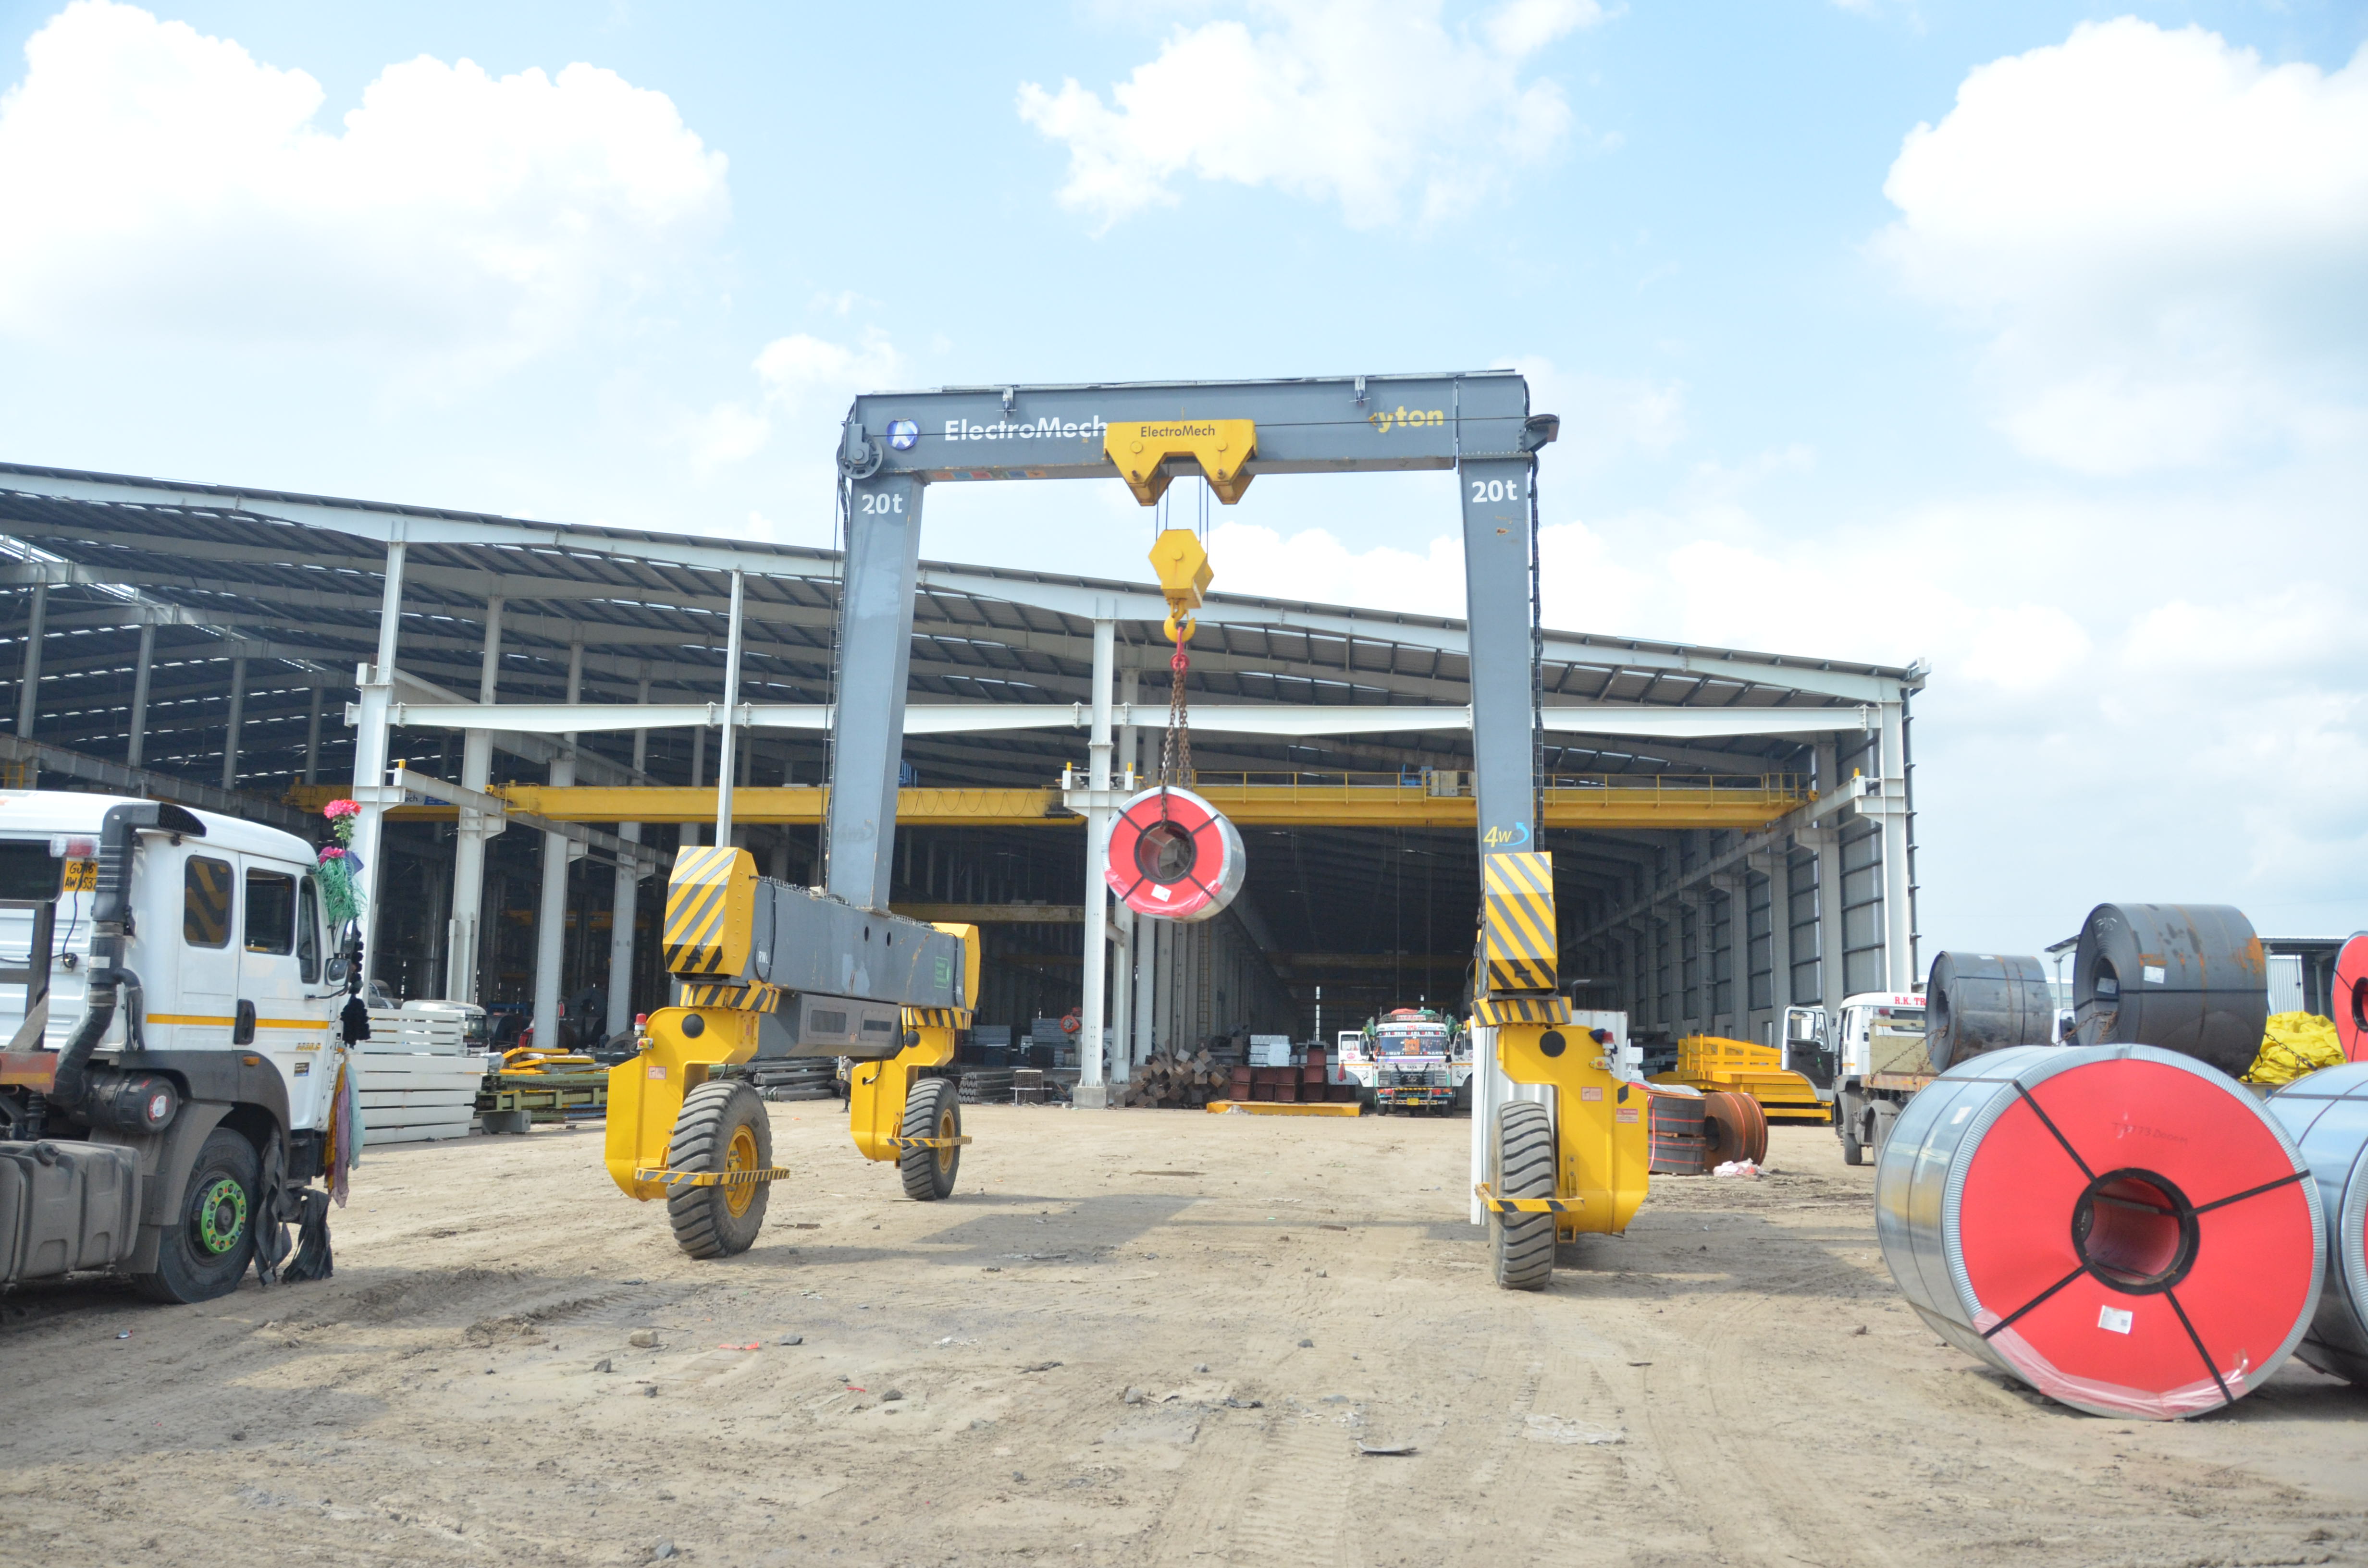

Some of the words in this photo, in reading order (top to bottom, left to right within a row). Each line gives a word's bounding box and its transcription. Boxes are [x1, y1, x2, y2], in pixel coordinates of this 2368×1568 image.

[945, 415, 1108, 441] ElectroMech
[1141, 424, 1215, 438] ElectroMech
[1472, 479, 1517, 503] 20t
[862, 493, 903, 514] 20t
